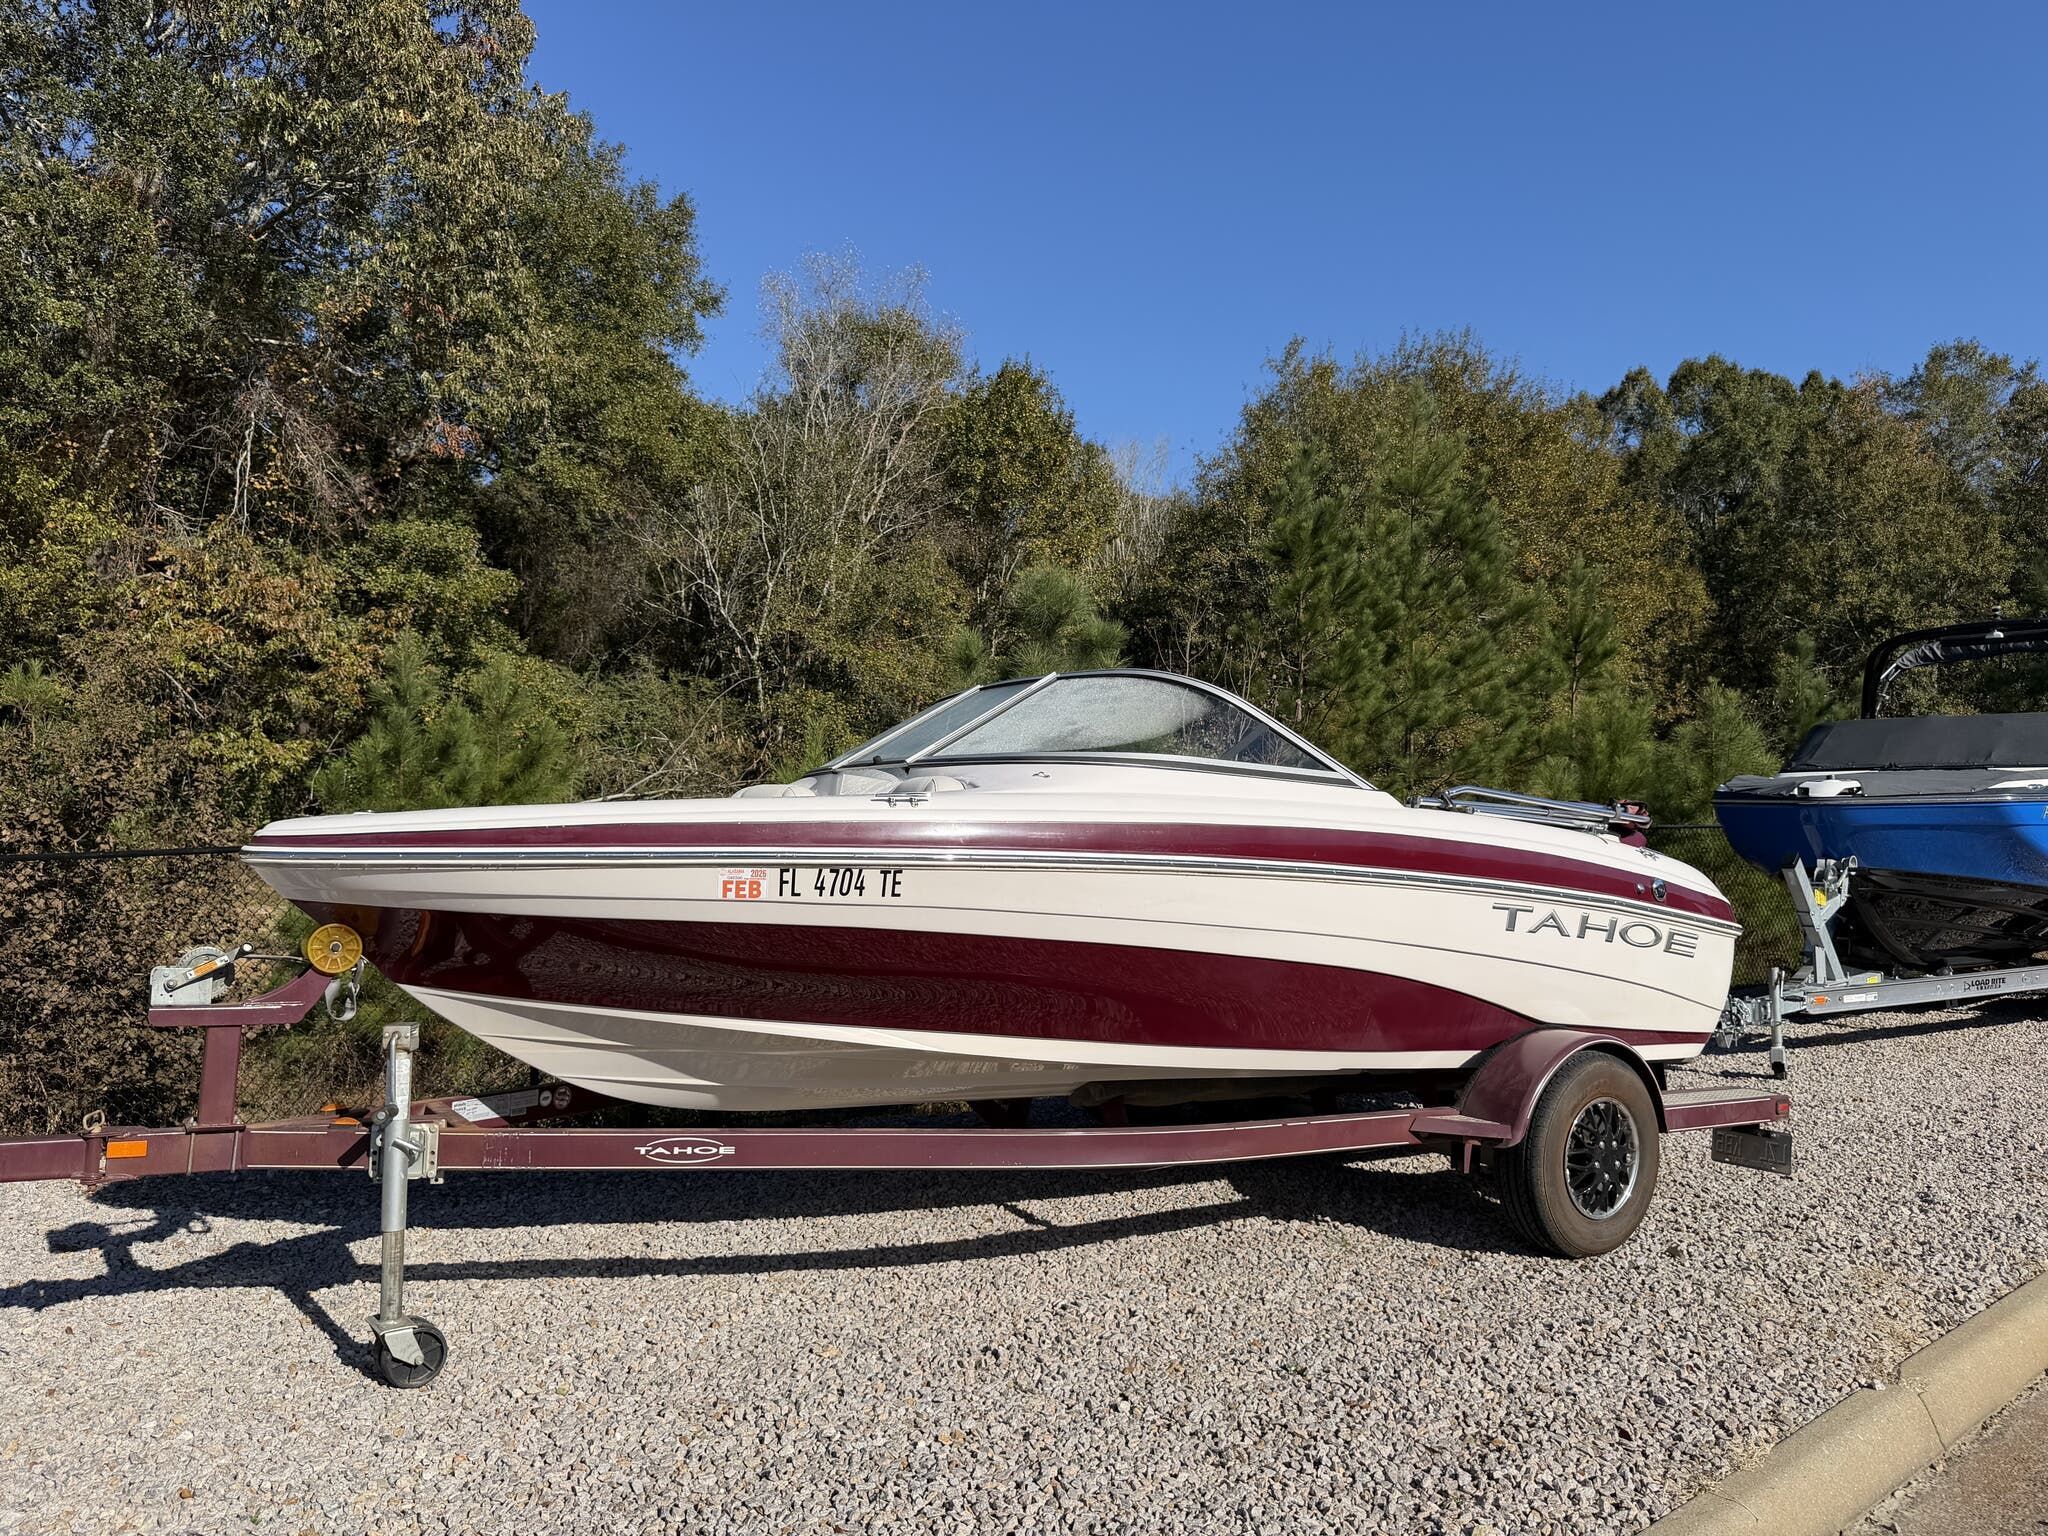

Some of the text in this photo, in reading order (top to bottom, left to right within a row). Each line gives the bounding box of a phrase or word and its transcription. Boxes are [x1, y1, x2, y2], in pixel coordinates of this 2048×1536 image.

[722, 880, 761, 898] FEB
[779, 868, 903, 897] FL 4704 TE
[1492, 902, 1700, 958] TAHOE
[1991, 977, 2006, 985] RITE
[634, 1146, 736, 1155] TAHOE
